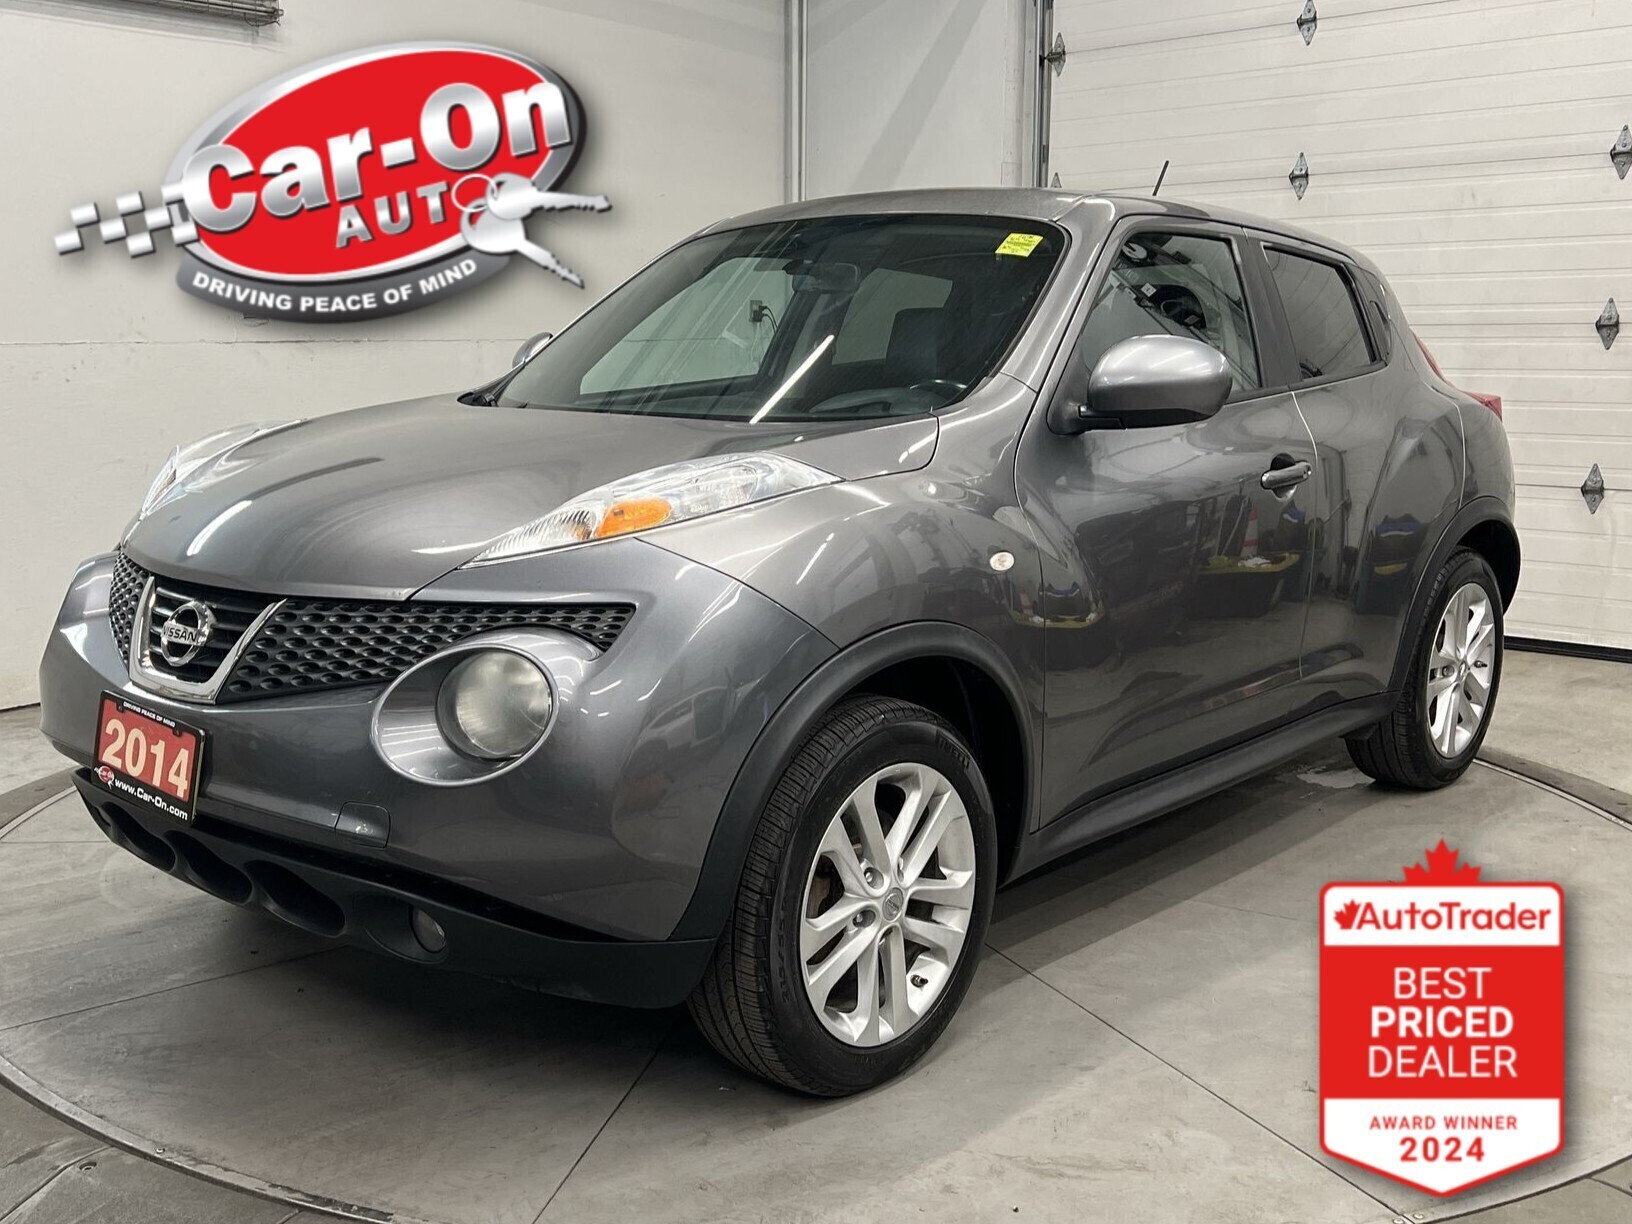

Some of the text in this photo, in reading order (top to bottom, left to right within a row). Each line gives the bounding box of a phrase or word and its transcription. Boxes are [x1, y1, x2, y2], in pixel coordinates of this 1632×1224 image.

[163, 625, 199, 643] NISSAN
[101, 718, 189, 798] 2014
[115, 778, 188, 820] www.Car-On.com
